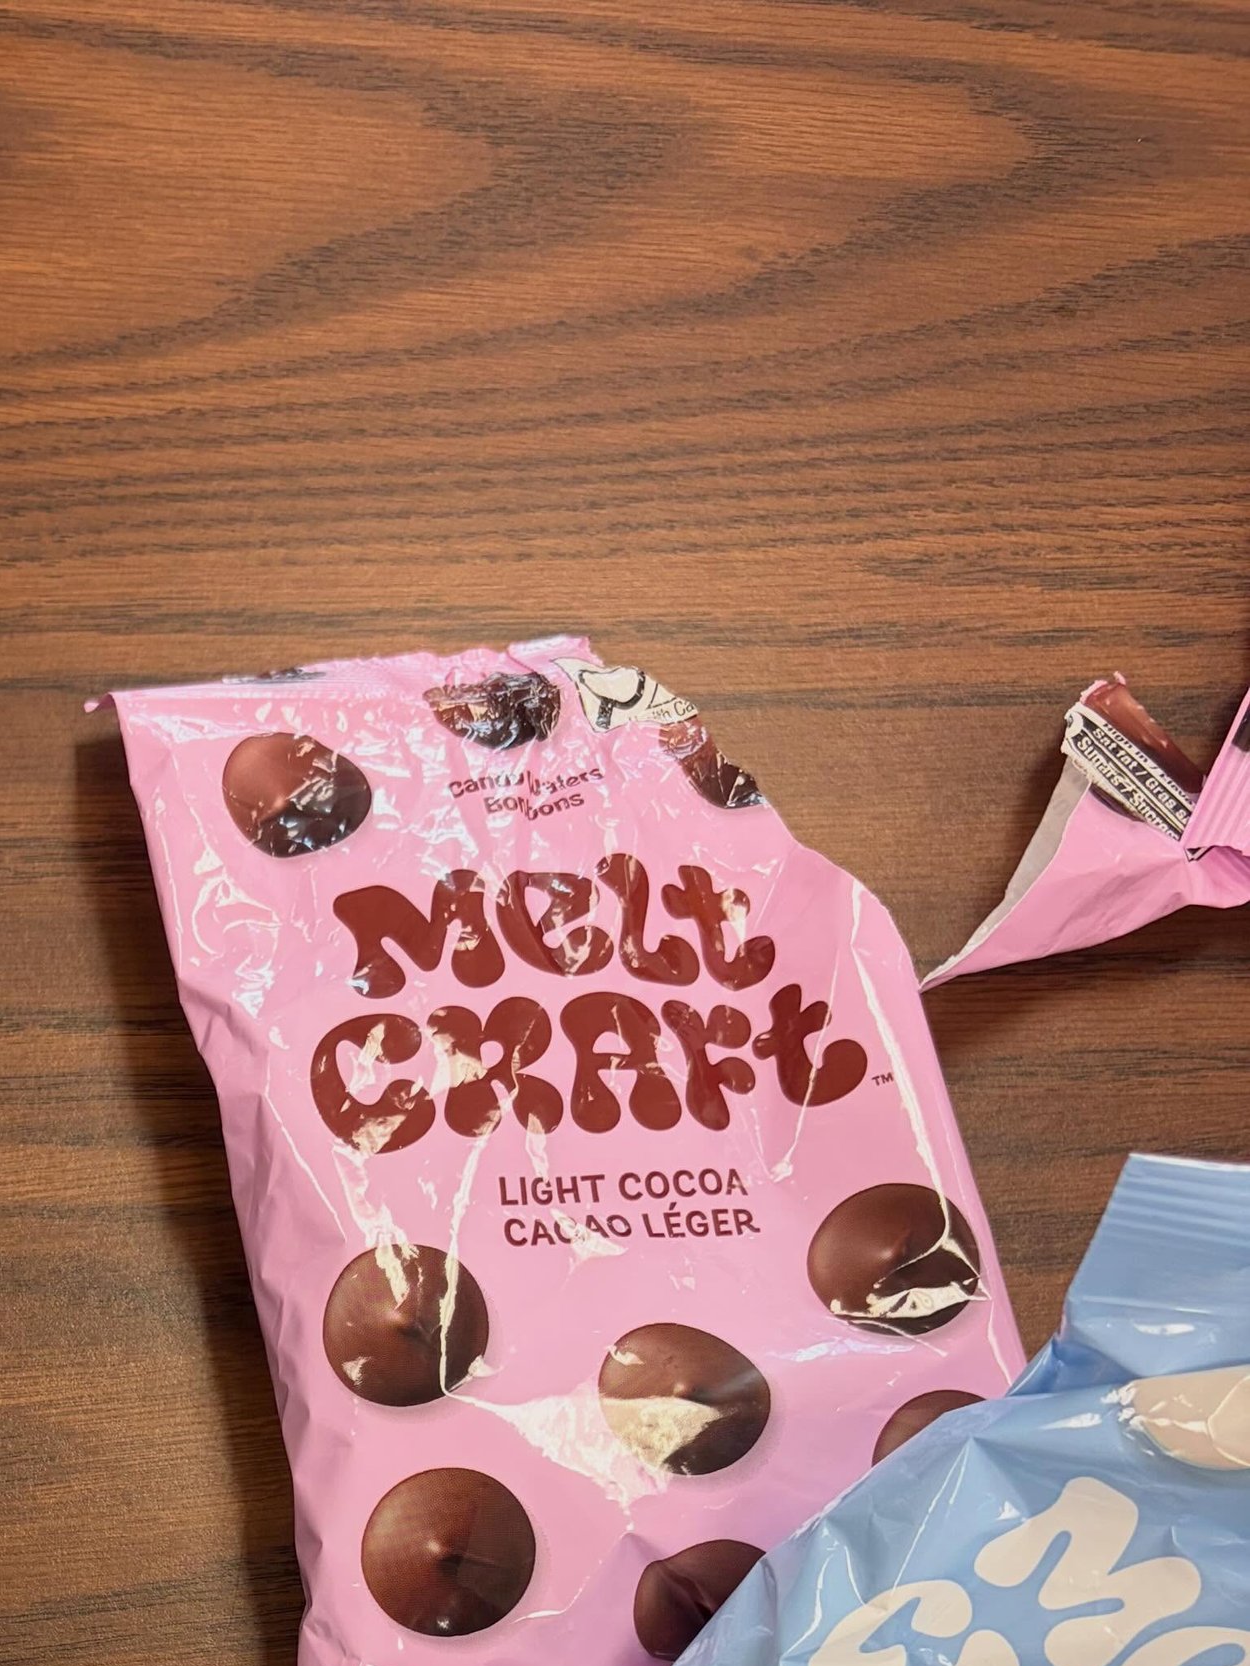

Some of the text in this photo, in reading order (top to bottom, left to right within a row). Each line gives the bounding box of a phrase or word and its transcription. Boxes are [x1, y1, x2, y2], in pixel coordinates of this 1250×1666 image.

[498, 1167, 749, 1206] LIGHT COCOA
[503, 1201, 761, 1247] CACAO LÉGER
